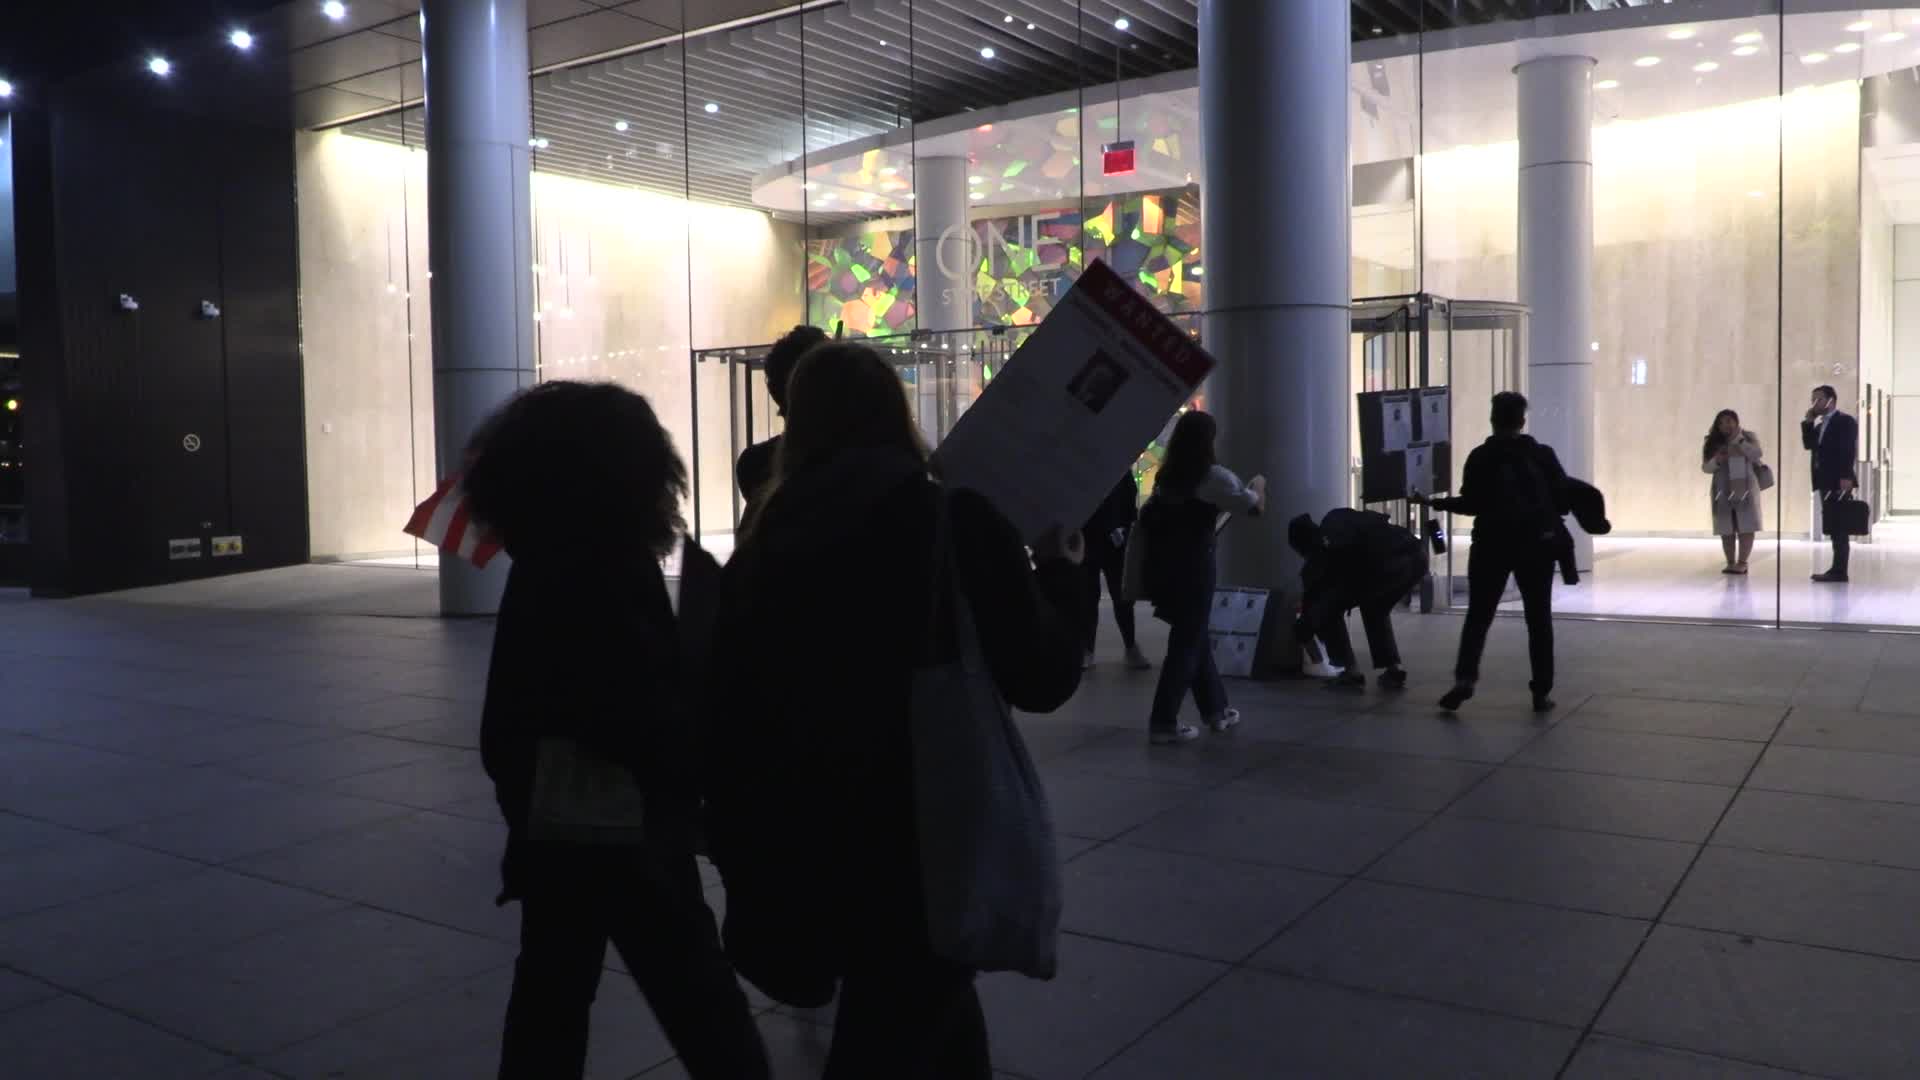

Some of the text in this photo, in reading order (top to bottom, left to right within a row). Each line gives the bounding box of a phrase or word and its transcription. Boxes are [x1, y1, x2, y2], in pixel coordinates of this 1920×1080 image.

[936, 212, 1062, 280] ONE
[994, 277, 1062, 301] STREET
[1104, 283, 1190, 364] WANTED
